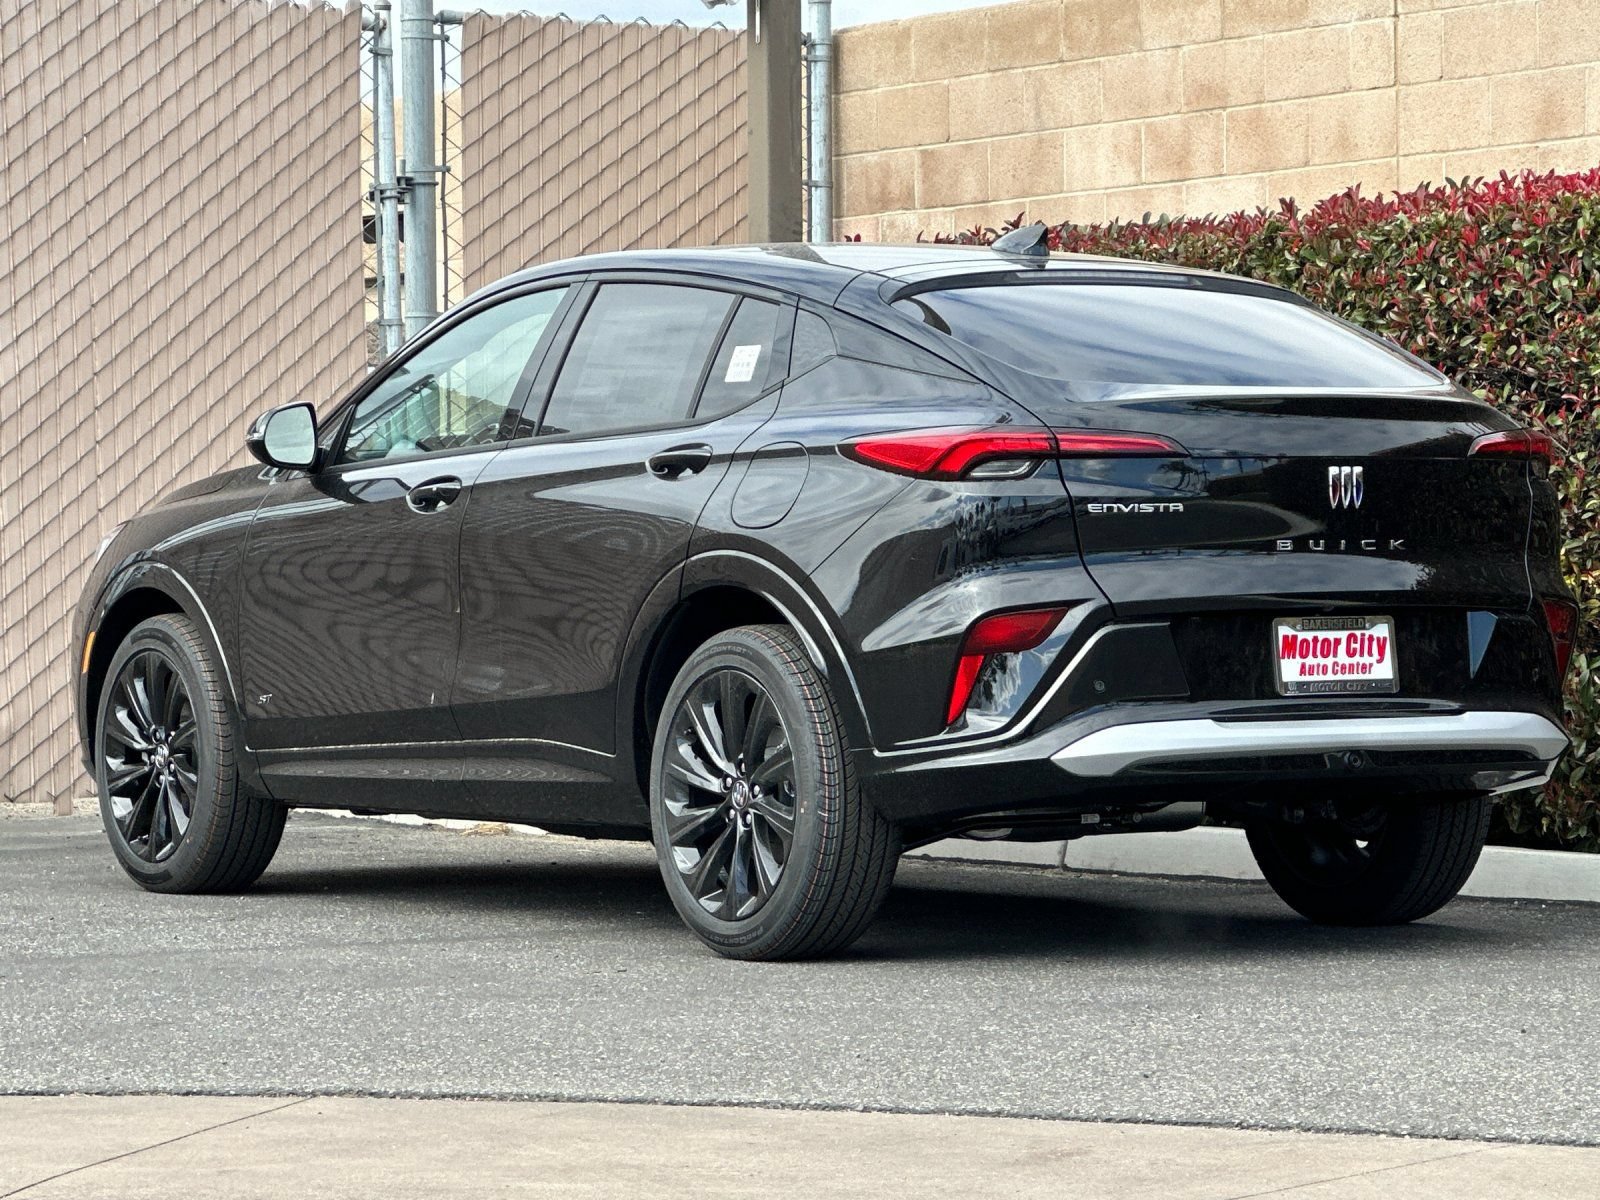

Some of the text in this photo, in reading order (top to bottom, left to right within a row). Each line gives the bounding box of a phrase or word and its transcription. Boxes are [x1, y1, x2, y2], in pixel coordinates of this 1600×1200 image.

[1087, 502, 1184, 513] ENVISTA
[1276, 539, 1406, 551] BUICK
[1303, 618, 1365, 630] BAKERSFIELD
[1280, 632, 1388, 664] Motor City
[1299, 661, 1374, 677] Auto Center
[1309, 681, 1345, 692] MOTOR
[1346, 680, 1369, 691] CITY
[257, 693, 273, 705] ST
